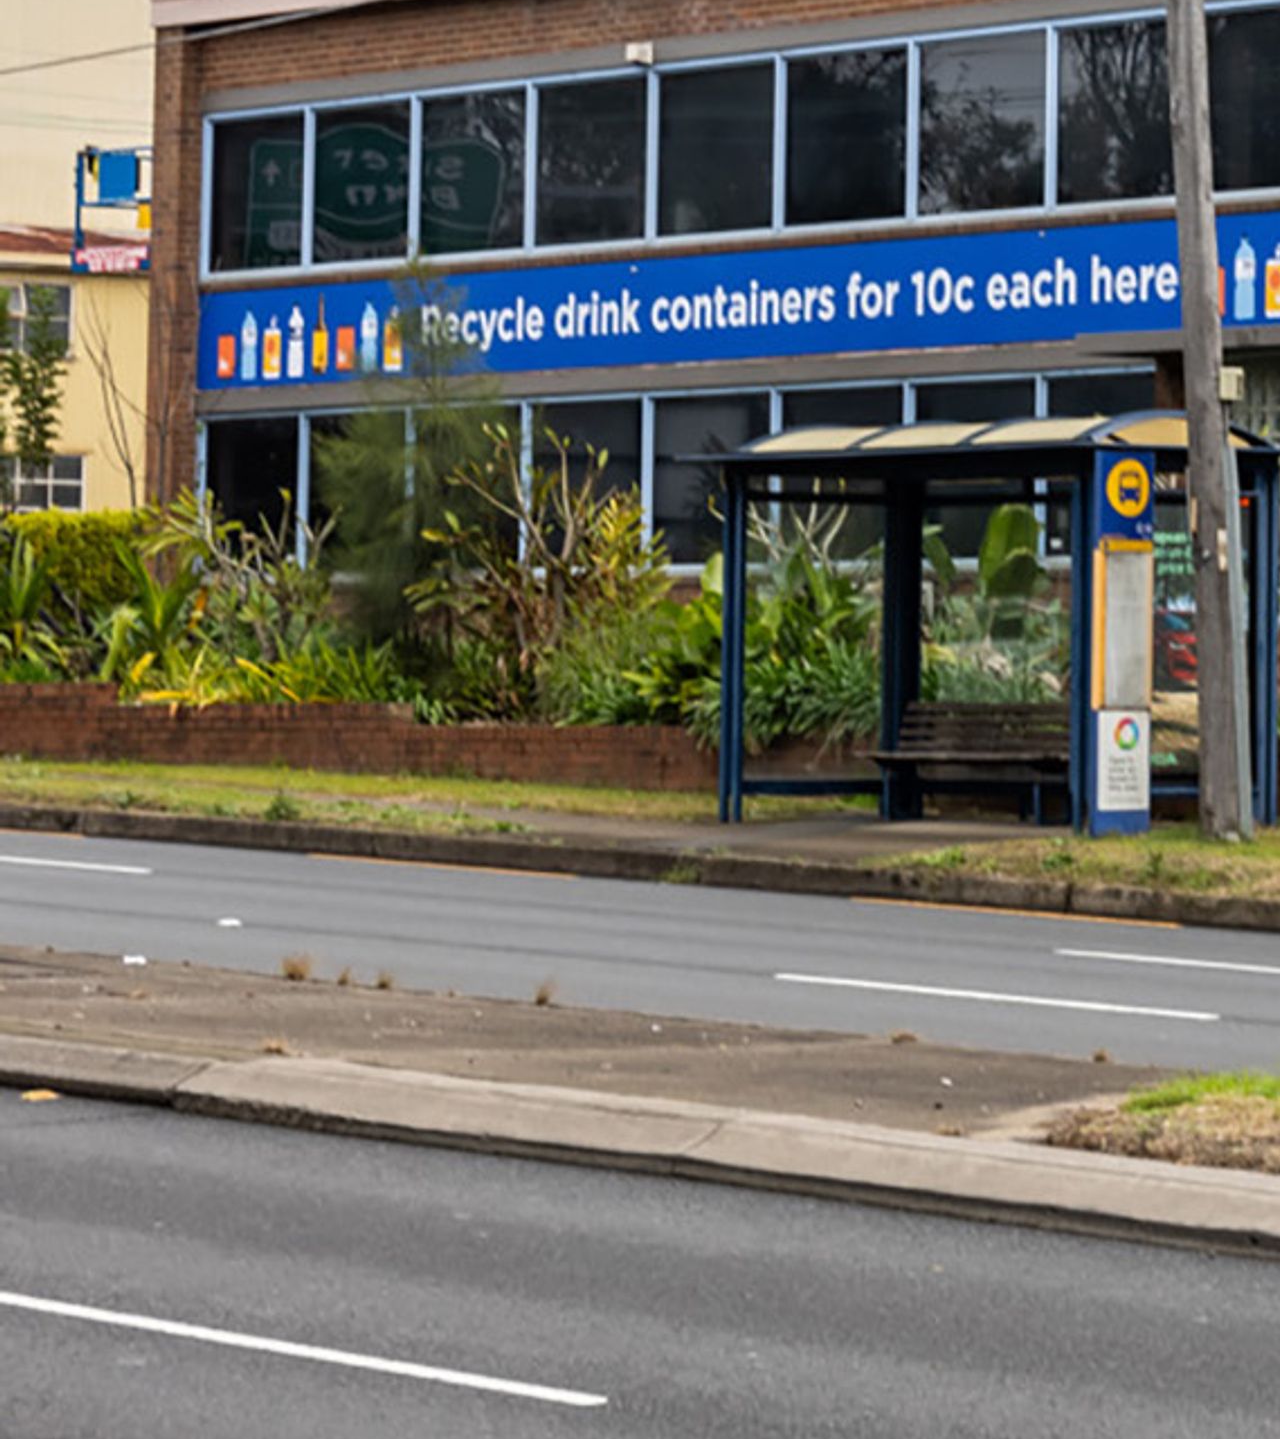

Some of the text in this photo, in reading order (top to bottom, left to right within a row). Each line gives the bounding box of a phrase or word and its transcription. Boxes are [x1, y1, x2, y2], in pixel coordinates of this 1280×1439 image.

[554, 288, 641, 339] drink
[650, 280, 836, 334] containers
[847, 272, 899, 319] for
[912, 267, 975, 317] 10c
[986, 256, 1078, 311] each
[1090, 254, 1180, 304] here
